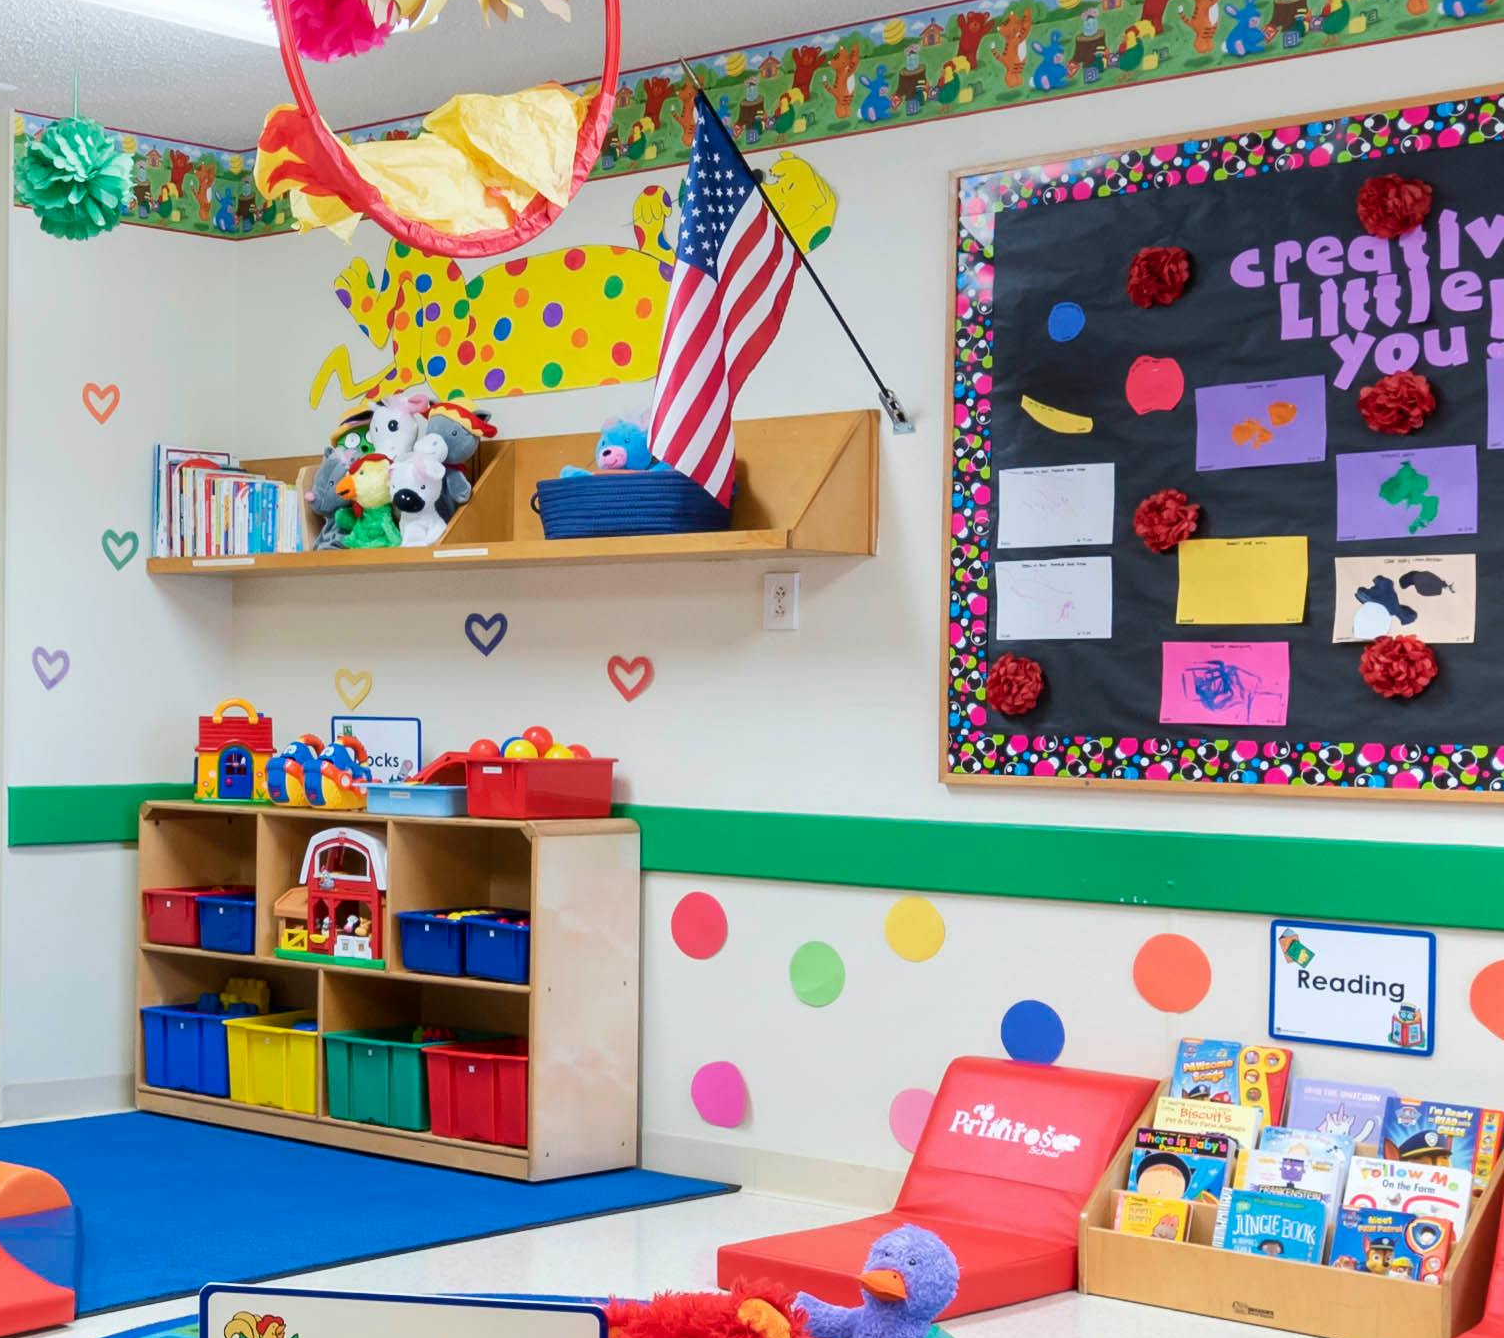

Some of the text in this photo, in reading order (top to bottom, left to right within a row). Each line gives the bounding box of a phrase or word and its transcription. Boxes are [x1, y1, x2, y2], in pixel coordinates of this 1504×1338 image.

[368, 753, 399, 768] ocks
[1299, 970, 1404, 1002] Reading
[1179, 1107, 1232, 1123] Biscuit's
[1138, 1132, 1174, 1147] Where
[1189, 1137, 1228, 1153] Baby's
[1360, 1163, 1424, 1181] Follow
[1382, 1179, 1436, 1194] On the Farm
[1233, 1214, 1317, 1246] JUNGLE BOOK
